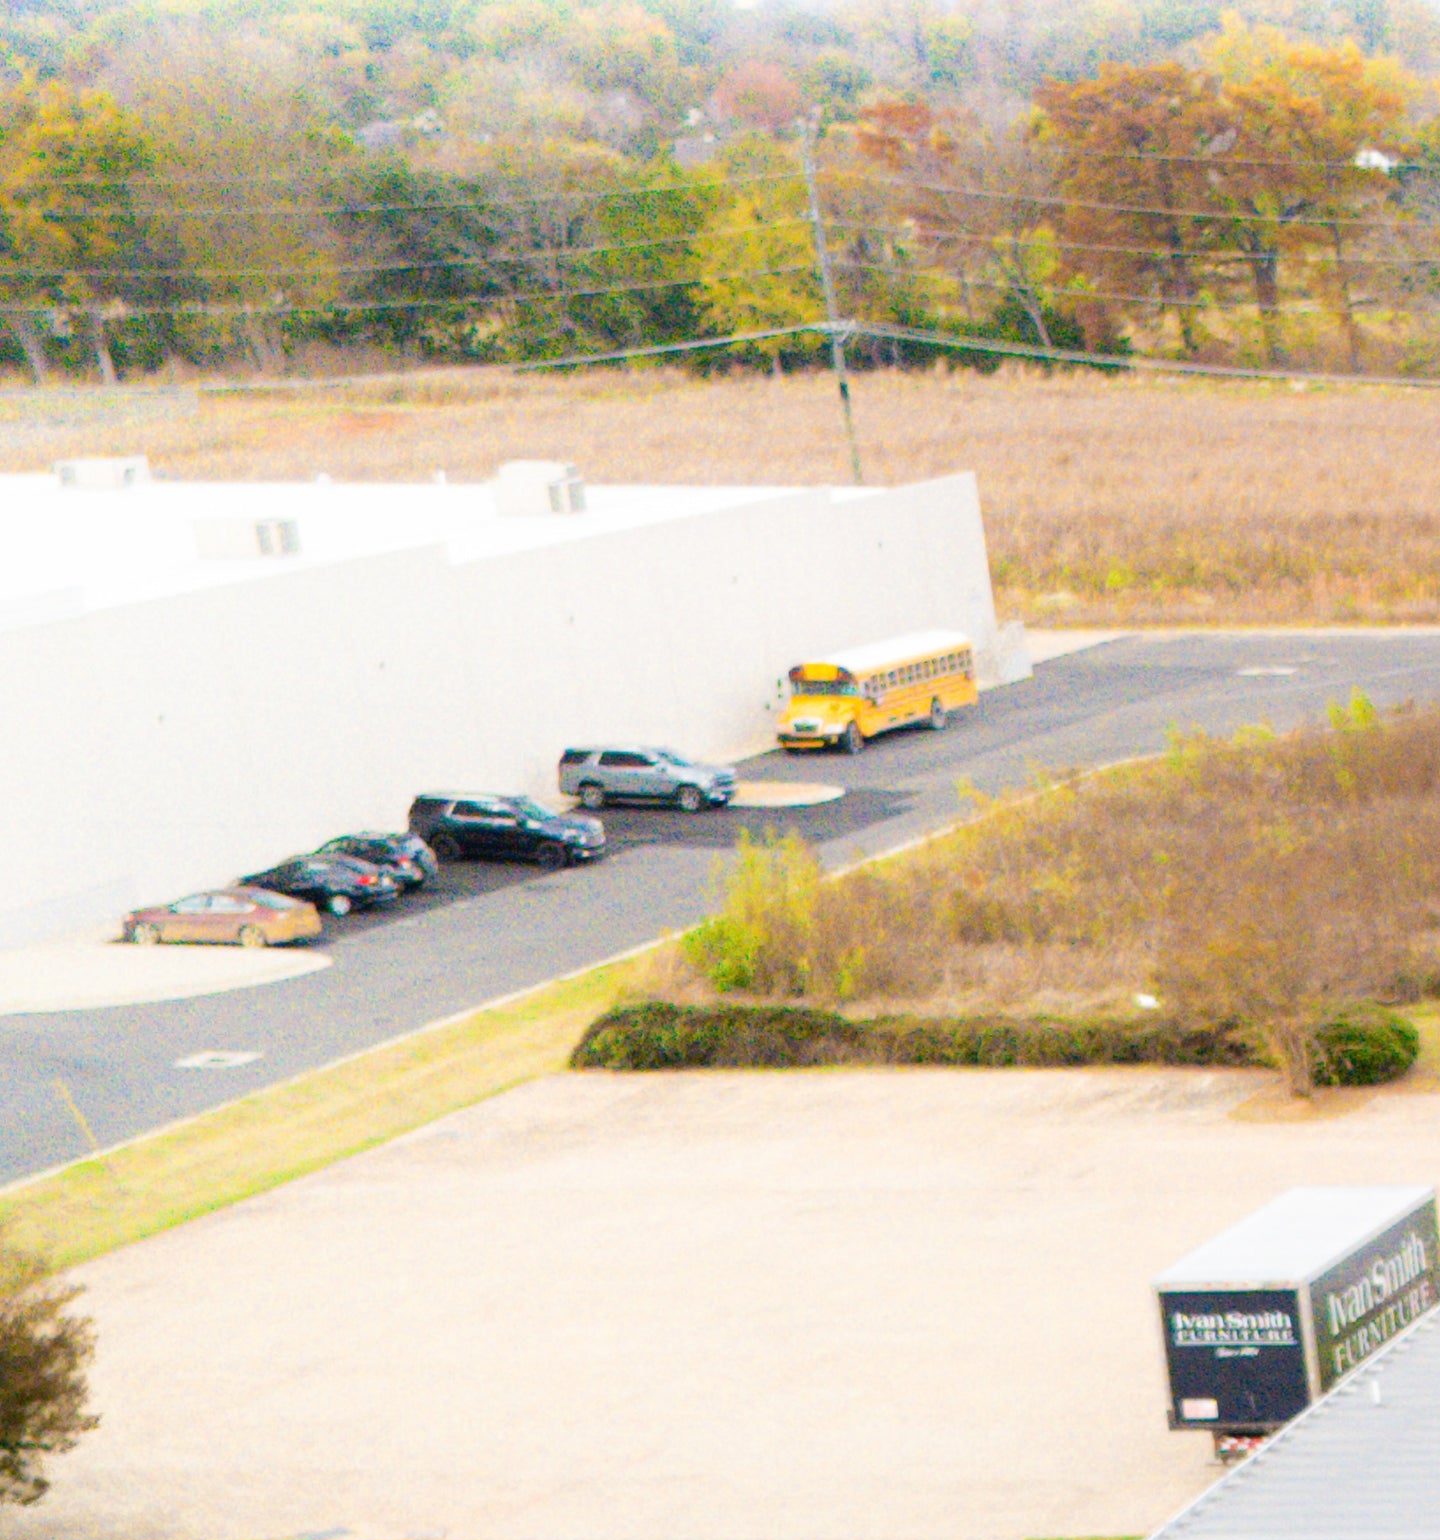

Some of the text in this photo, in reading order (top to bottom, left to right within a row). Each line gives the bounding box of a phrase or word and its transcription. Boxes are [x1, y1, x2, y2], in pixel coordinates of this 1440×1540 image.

[1328, 1231, 1426, 1335] Ivan Smith
[1174, 1310, 1292, 1329] Ivan Smith
[1175, 1329, 1294, 1341] FURNITURE
[1331, 1280, 1430, 1373] FURNITURE
